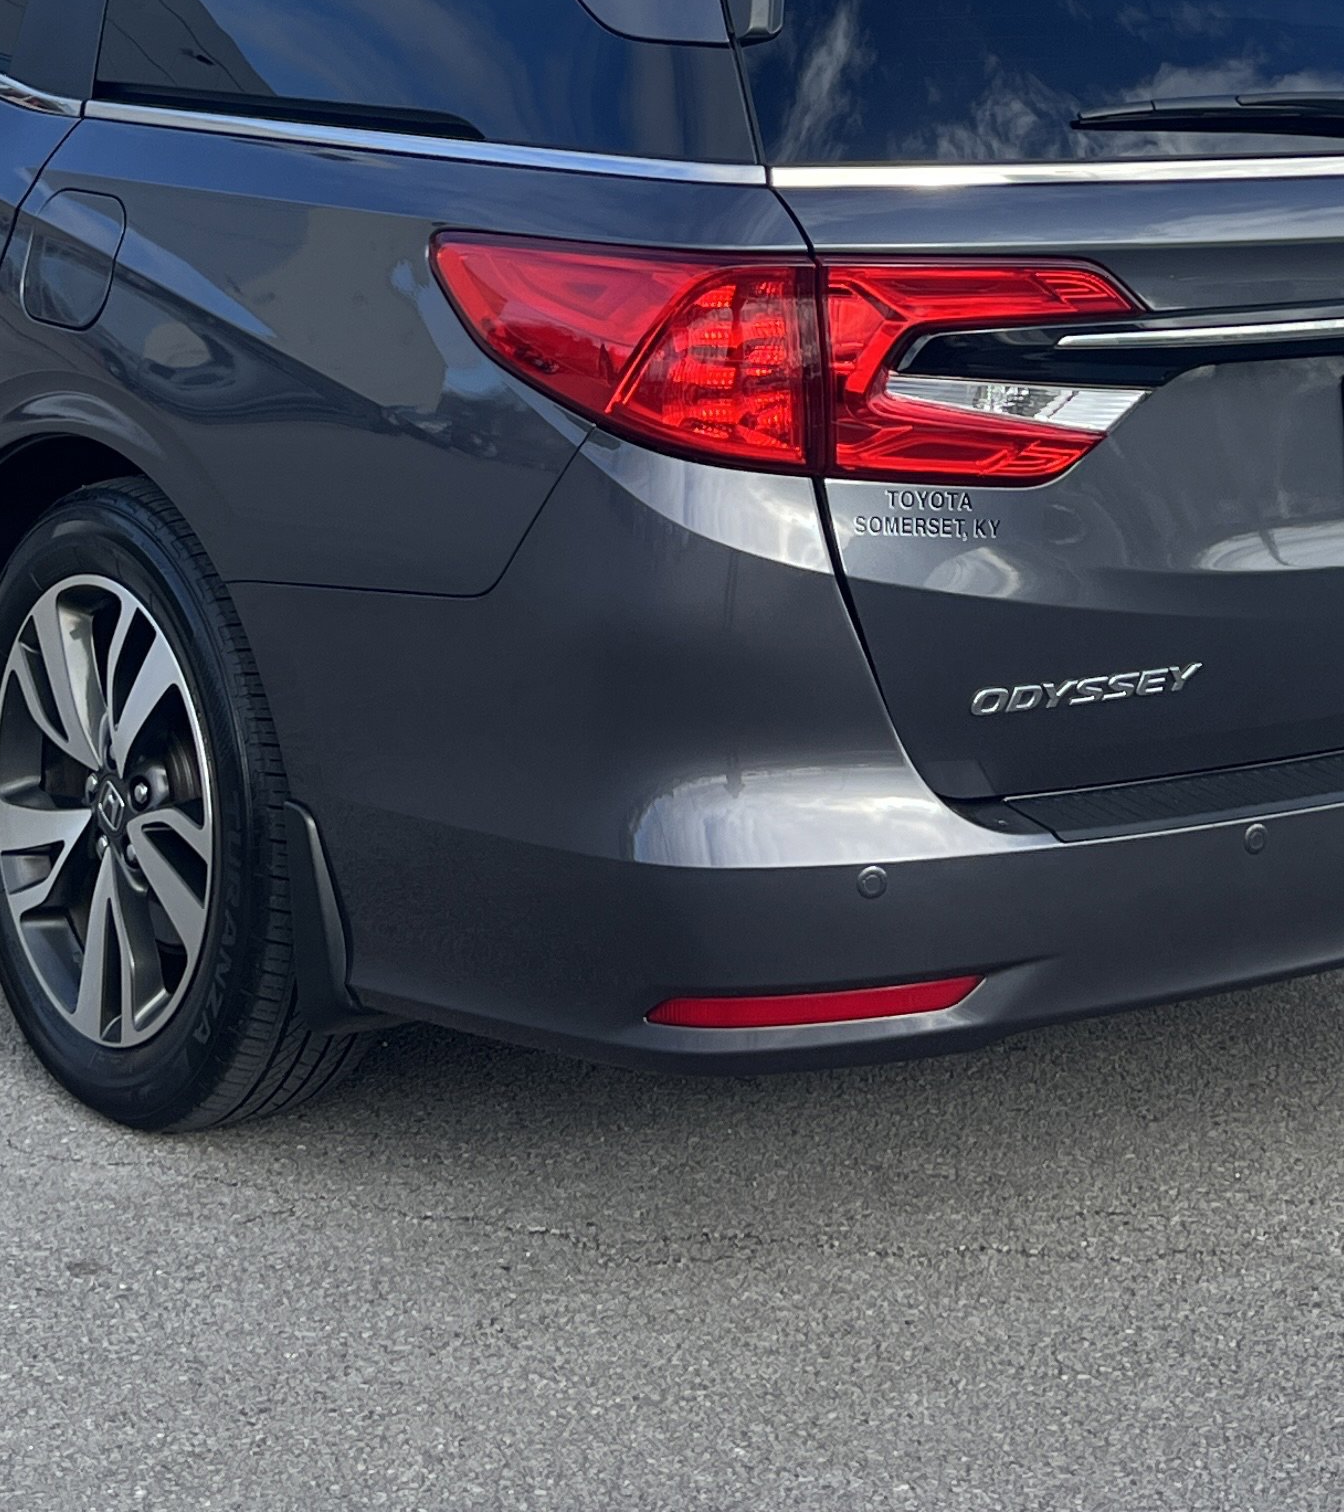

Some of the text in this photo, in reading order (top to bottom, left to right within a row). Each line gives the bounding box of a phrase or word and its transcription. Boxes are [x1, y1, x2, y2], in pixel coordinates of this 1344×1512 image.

[884, 490, 973, 512] TOYOTA
[854, 516, 1001, 541] SOMERSET, KY
[970, 662, 1203, 716] ODYSSEY
